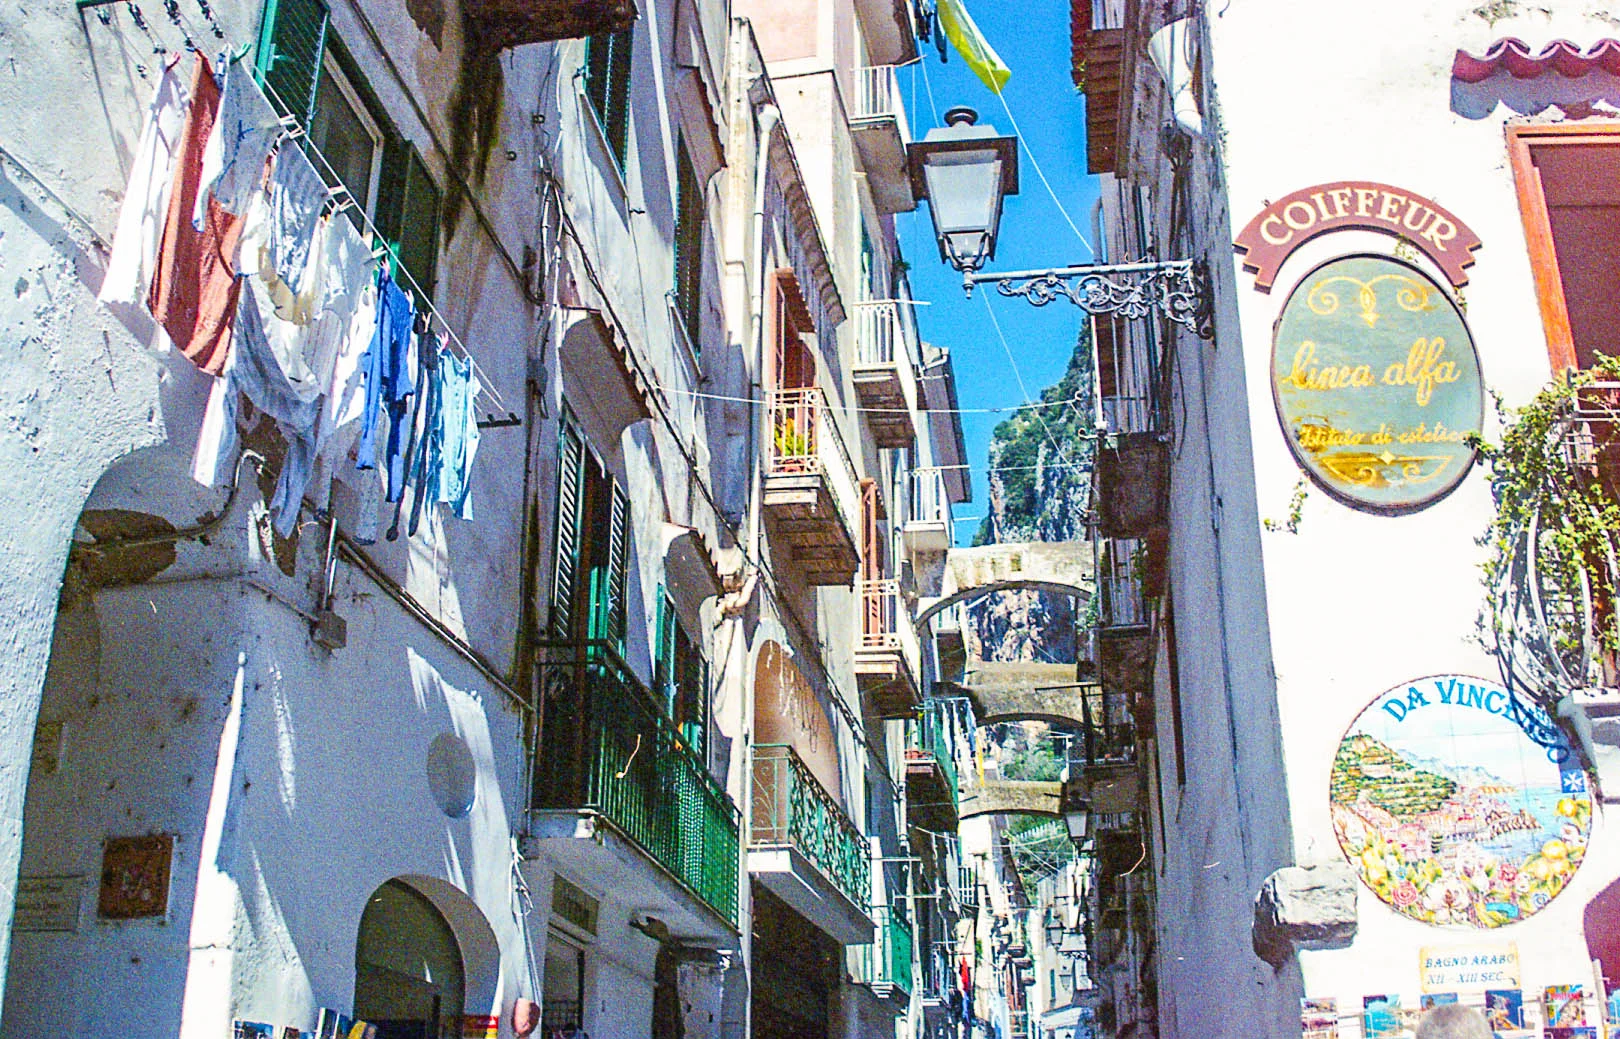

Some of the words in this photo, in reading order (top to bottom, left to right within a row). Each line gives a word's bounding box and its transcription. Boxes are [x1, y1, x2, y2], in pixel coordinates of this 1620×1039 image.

[1259, 186, 1458, 251] COIFFEUR
[1282, 340, 1375, 391] linea
[1381, 336, 1462, 407] alfa
[1371, 422, 1393, 445] di
[1381, 686, 1431, 723] DA
[1434, 678, 1570, 765] VINCO
[1425, 956, 1468, 968] BAGNO
[1471, 953, 1515, 966] ARABO
